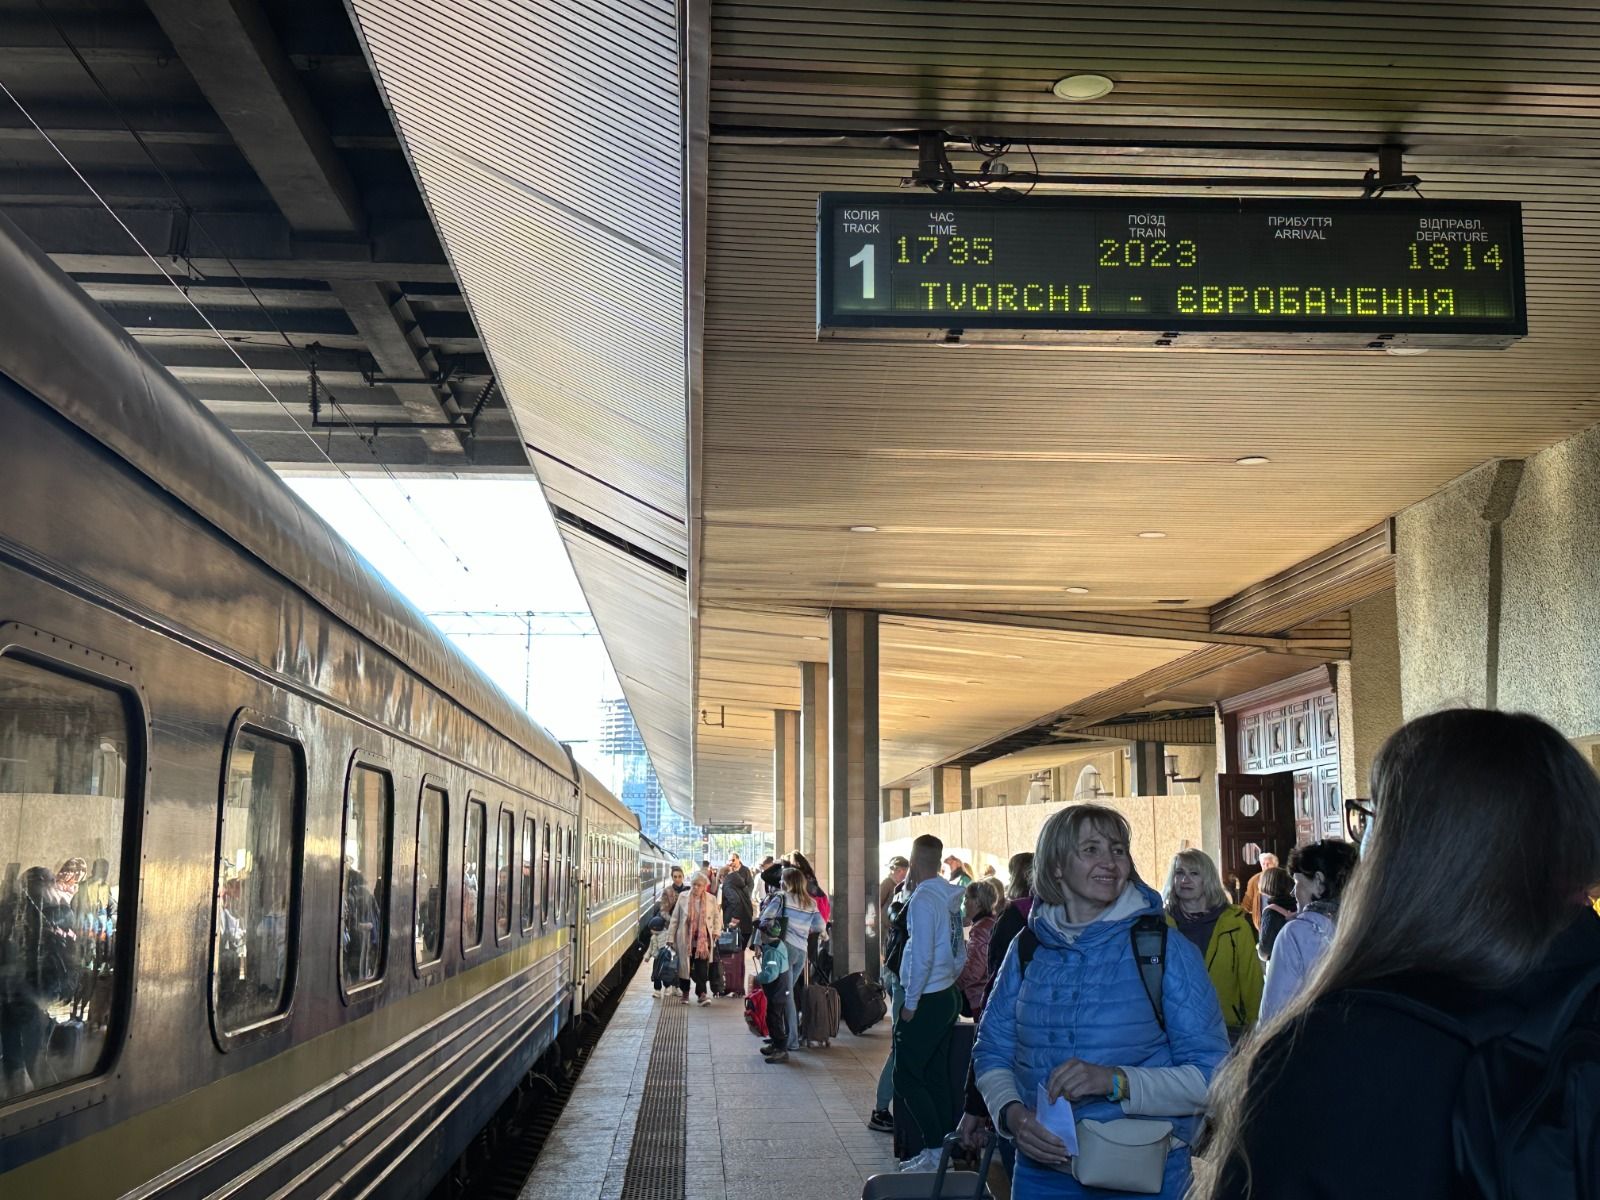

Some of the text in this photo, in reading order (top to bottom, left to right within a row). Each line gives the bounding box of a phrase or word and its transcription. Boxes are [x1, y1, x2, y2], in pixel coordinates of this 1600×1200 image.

[844, 210, 880, 222] КОЛІЯ
[930, 212, 955, 223] ЧАС
[1128, 213, 1166, 227] ПОЇЗД
[1268, 216, 1332, 228] ПРИБУТТЯ
[843, 223, 880, 234] TRACK
[928, 224, 958, 236] TIME
[1420, 218, 1484, 231] ВІДПРАВЛ.
[1129, 227, 1166, 238] TRAIN
[1274, 229, 1327, 240] ARRIVAL
[1416, 231, 1489, 243] DEPARTURE
[1099, 239, 1196, 267] 2023
[849, 244, 875, 299] 1
[920, 282, 1092, 312] TVORCHI
[1177, 286, 1455, 316] ЄВРОБАЧЕННЯ
